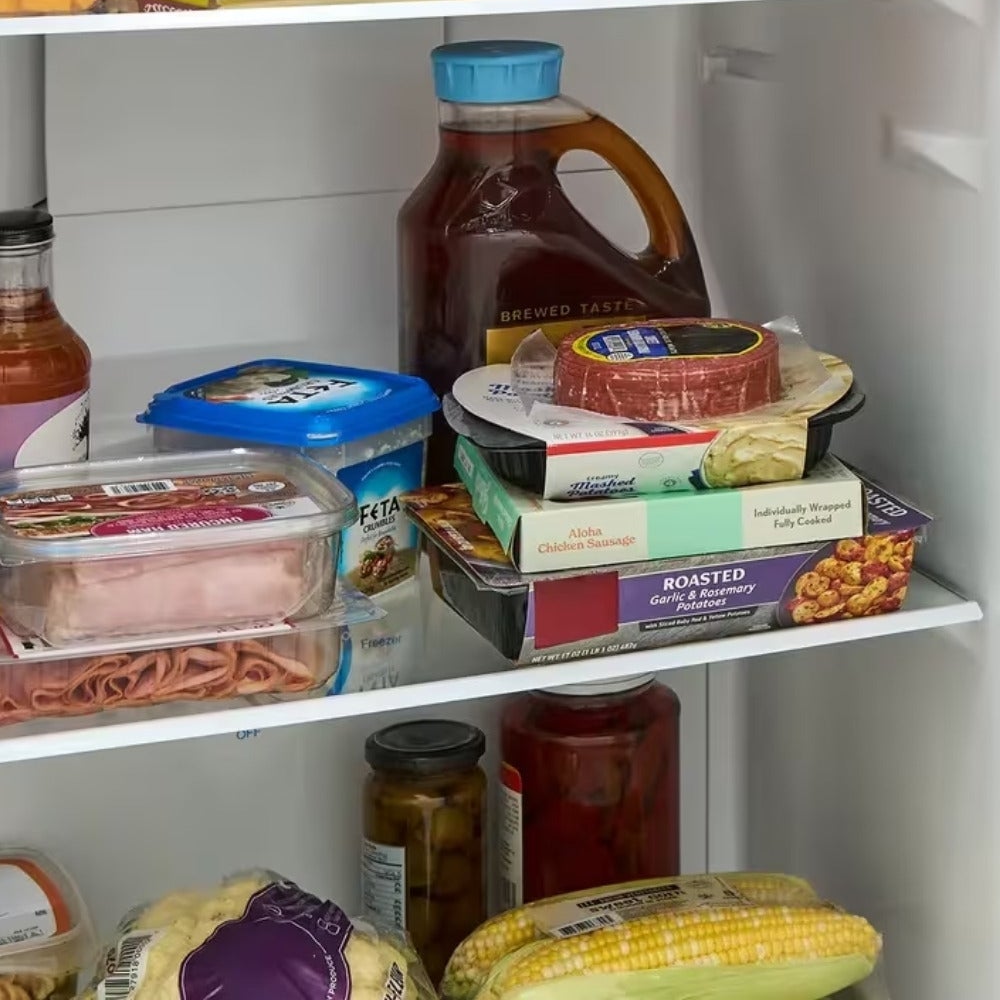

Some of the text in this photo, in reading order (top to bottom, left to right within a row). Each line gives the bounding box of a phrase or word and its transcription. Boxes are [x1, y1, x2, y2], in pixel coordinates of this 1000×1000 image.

[501, 301, 634, 322] BREWED TASTE
[570, 477, 636, 491] Mashed
[360, 496, 401, 526] FETA
[754, 500, 852, 518] Individually Wrapped
[774, 514, 832, 529] Fully Cooked
[568, 527, 602, 538] Aloha
[537, 535, 636, 554] Chicken Sausage
[663, 567, 746, 591] ROASTED
[650, 582, 757, 606] Garlic & Rosemary
[676, 596, 727, 612] Potatoes
[532, 655, 546, 663] NET
[328, 954, 339, 997] PRODUCE
